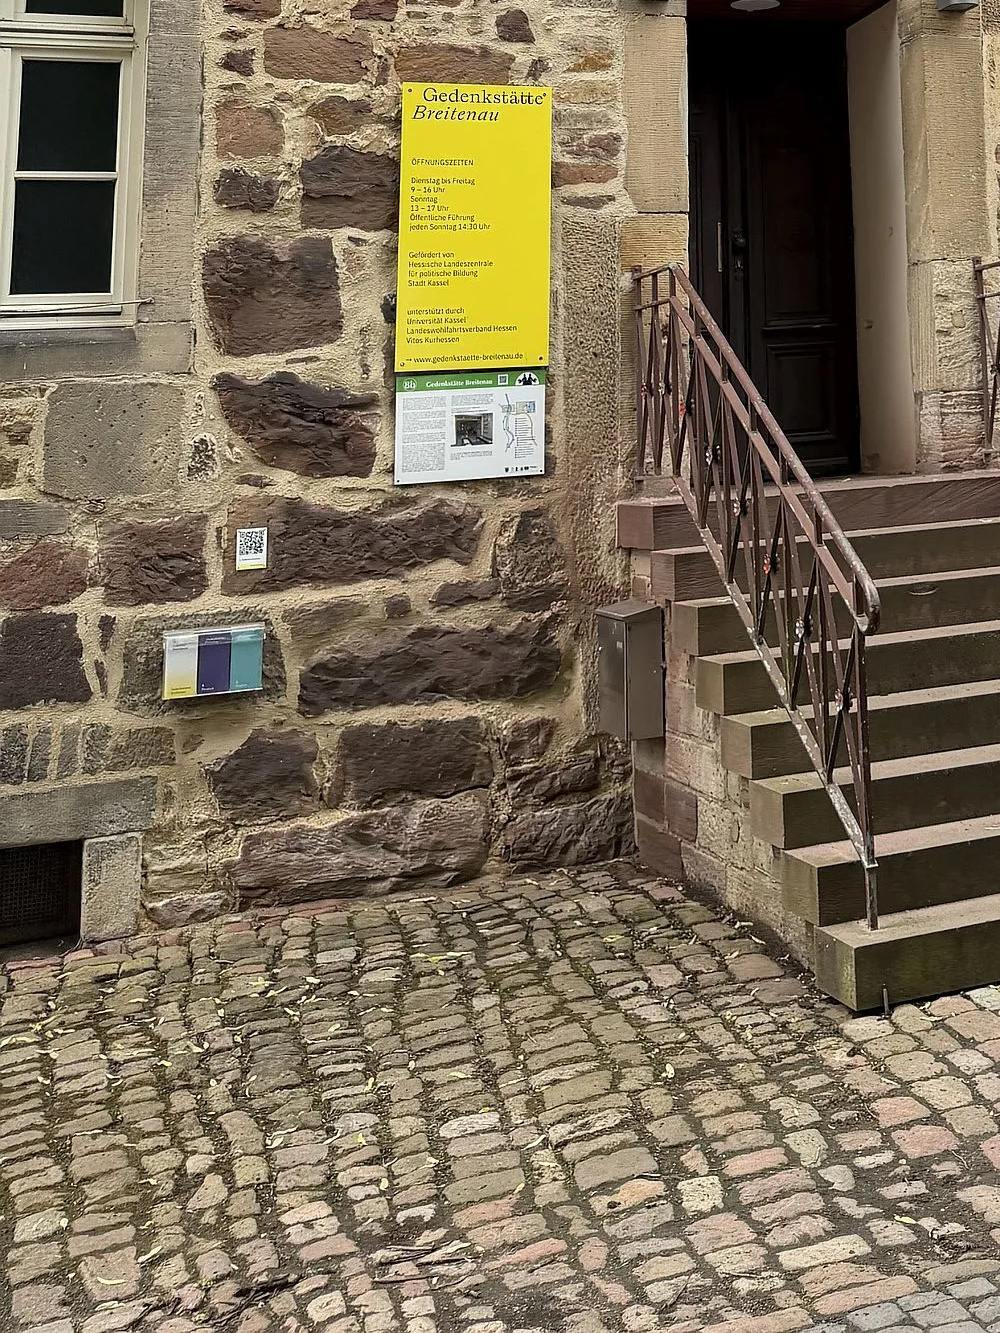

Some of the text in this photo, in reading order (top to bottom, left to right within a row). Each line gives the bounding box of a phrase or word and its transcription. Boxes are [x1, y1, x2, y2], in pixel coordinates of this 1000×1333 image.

[423, 87, 544, 105] Gedenkstätte
[411, 105, 500, 121] Breitenau
[411, 158, 474, 166] ÖFFNUNGSZEITEN
[411, 177, 440, 185] Dienstag
[410, 196, 438, 204] Sonntag
[410, 213, 475, 222] Öffentliche Führung
[419, 270, 451, 278] politische
[453, 270, 478, 278] Bildung
[406, 317, 442, 325] Universität
[406, 325, 492, 334] Landeswohlfahrtsverband
[424, 336, 459, 344] Kurhessen
[413, 353, 523, 364] www.gedenkstaette-breitenau.de
[426, 380, 464, 388] Gedenkstätte
